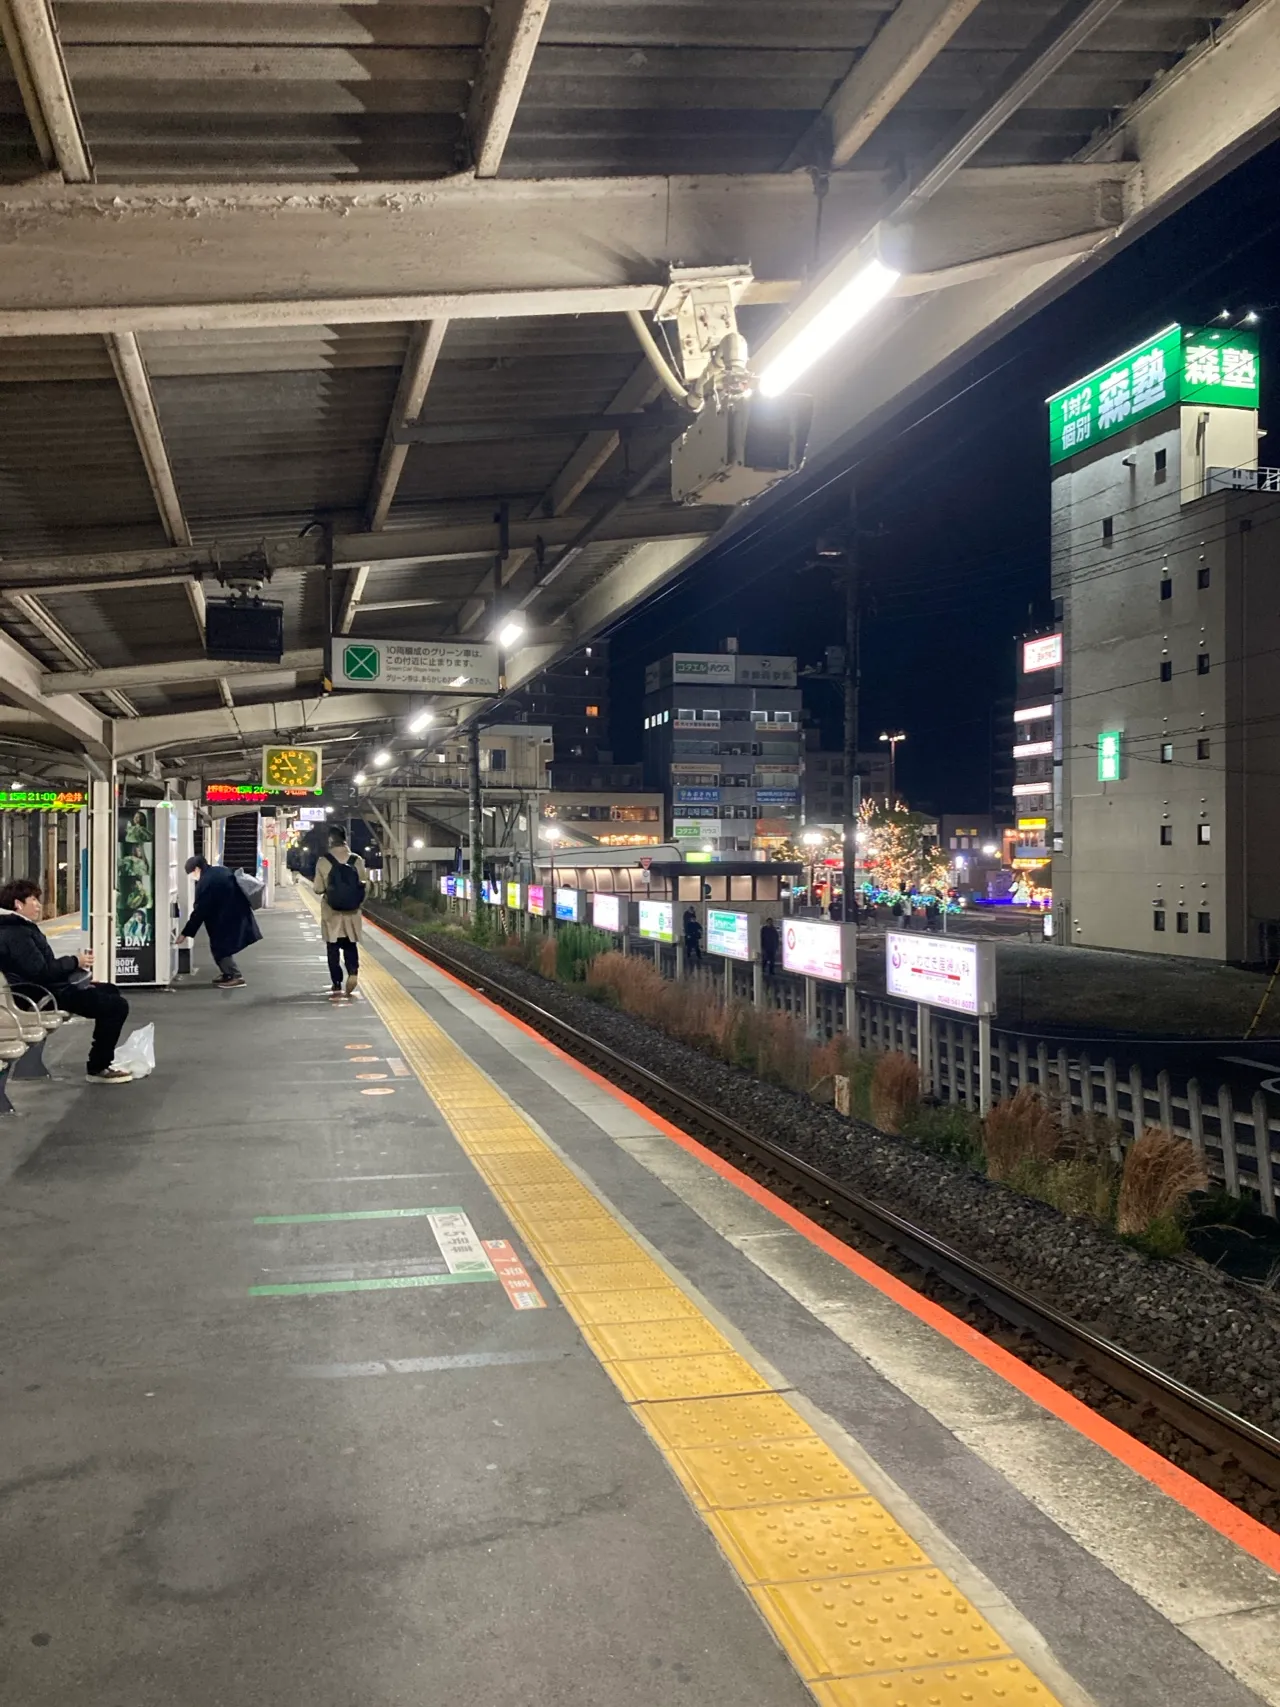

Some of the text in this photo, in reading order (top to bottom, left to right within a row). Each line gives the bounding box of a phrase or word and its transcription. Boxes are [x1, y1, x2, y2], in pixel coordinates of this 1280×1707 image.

[1184, 345, 1256, 389] 森塾
[1097, 347, 1167, 430] 森塾
[1062, 414, 1091, 450] 個別
[385, 656, 474, 668] この付近に止まります。
[27, 792, 57, 801] 21:00
[57, 792, 83, 802] 小金井
[125, 935, 150, 947] DAY.
[115, 964, 139, 974] AINTÉ
